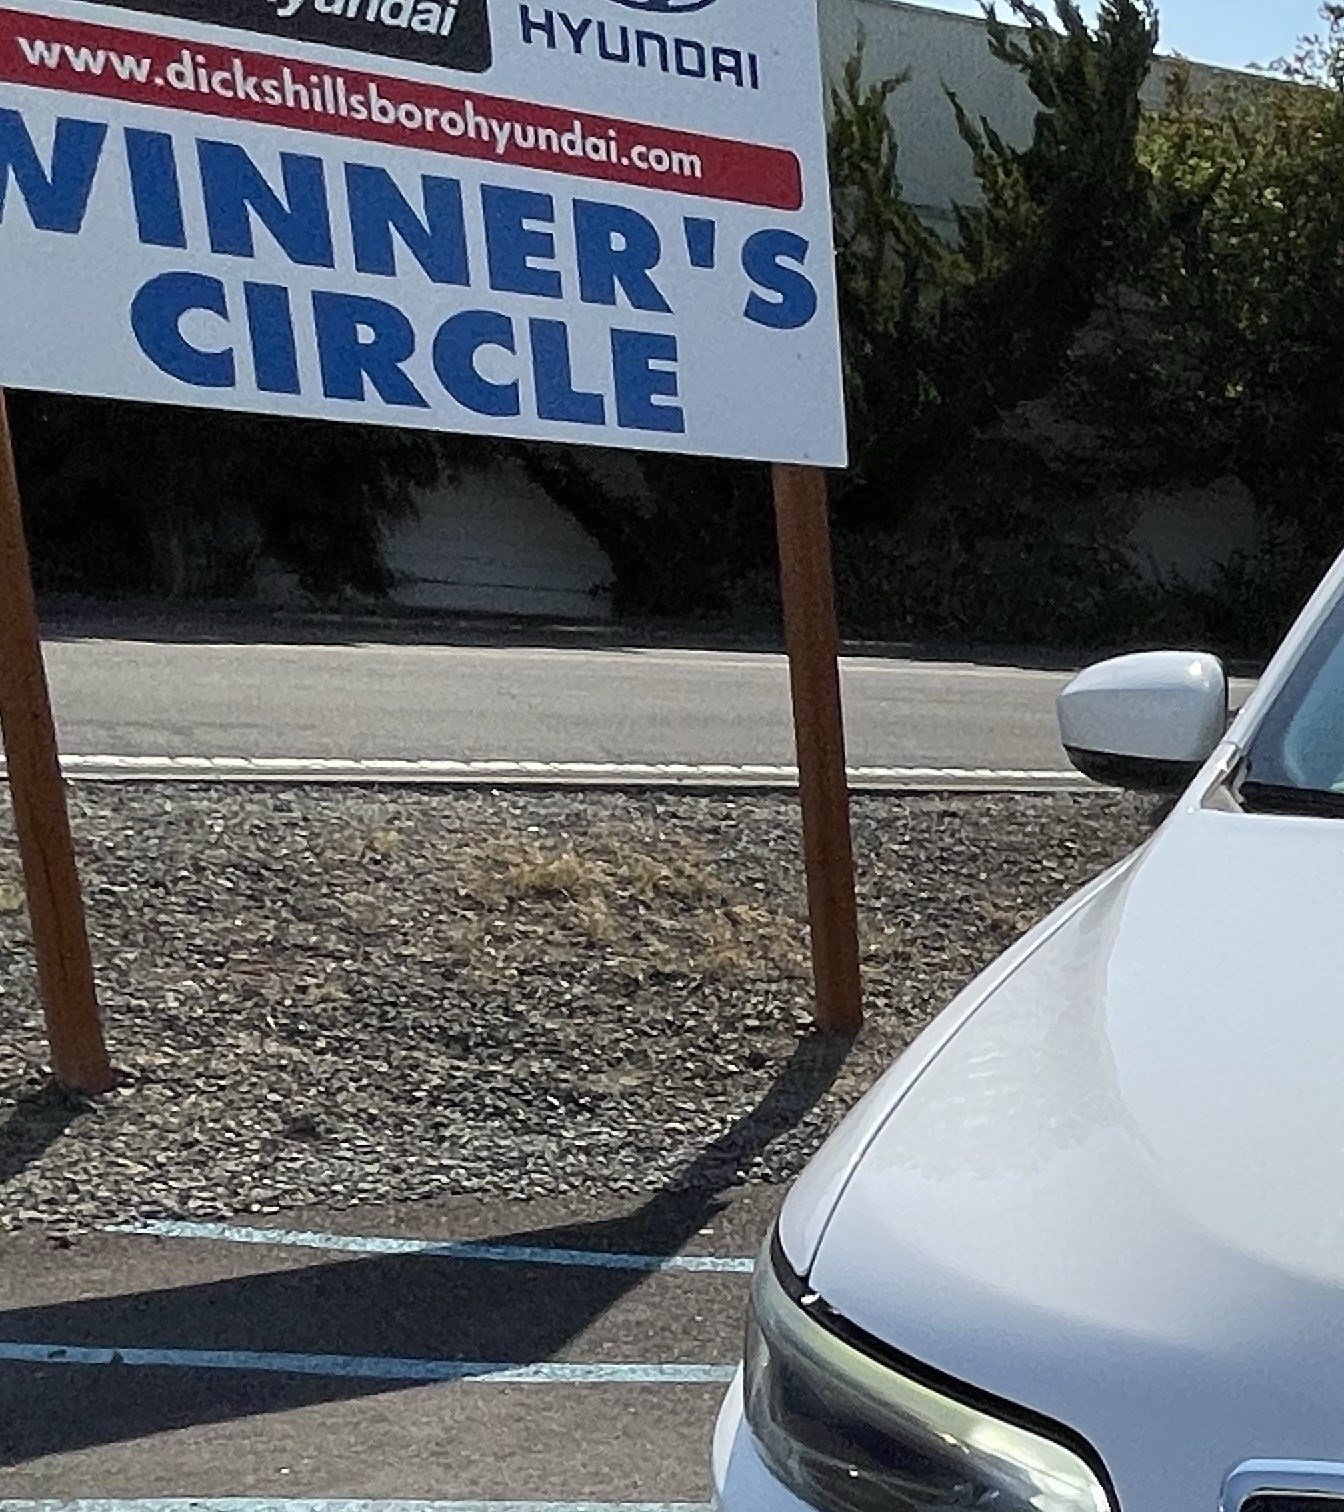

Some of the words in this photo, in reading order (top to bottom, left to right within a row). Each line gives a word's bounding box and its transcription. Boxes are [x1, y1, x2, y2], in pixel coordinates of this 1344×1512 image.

[16, 36, 704, 180] www.dickshillsborohyundai.com
[519, 5, 760, 90] HYUNDAI
[0, 107, 819, 330] WINNER'S
[130, 272, 686, 434] CIRCLE
